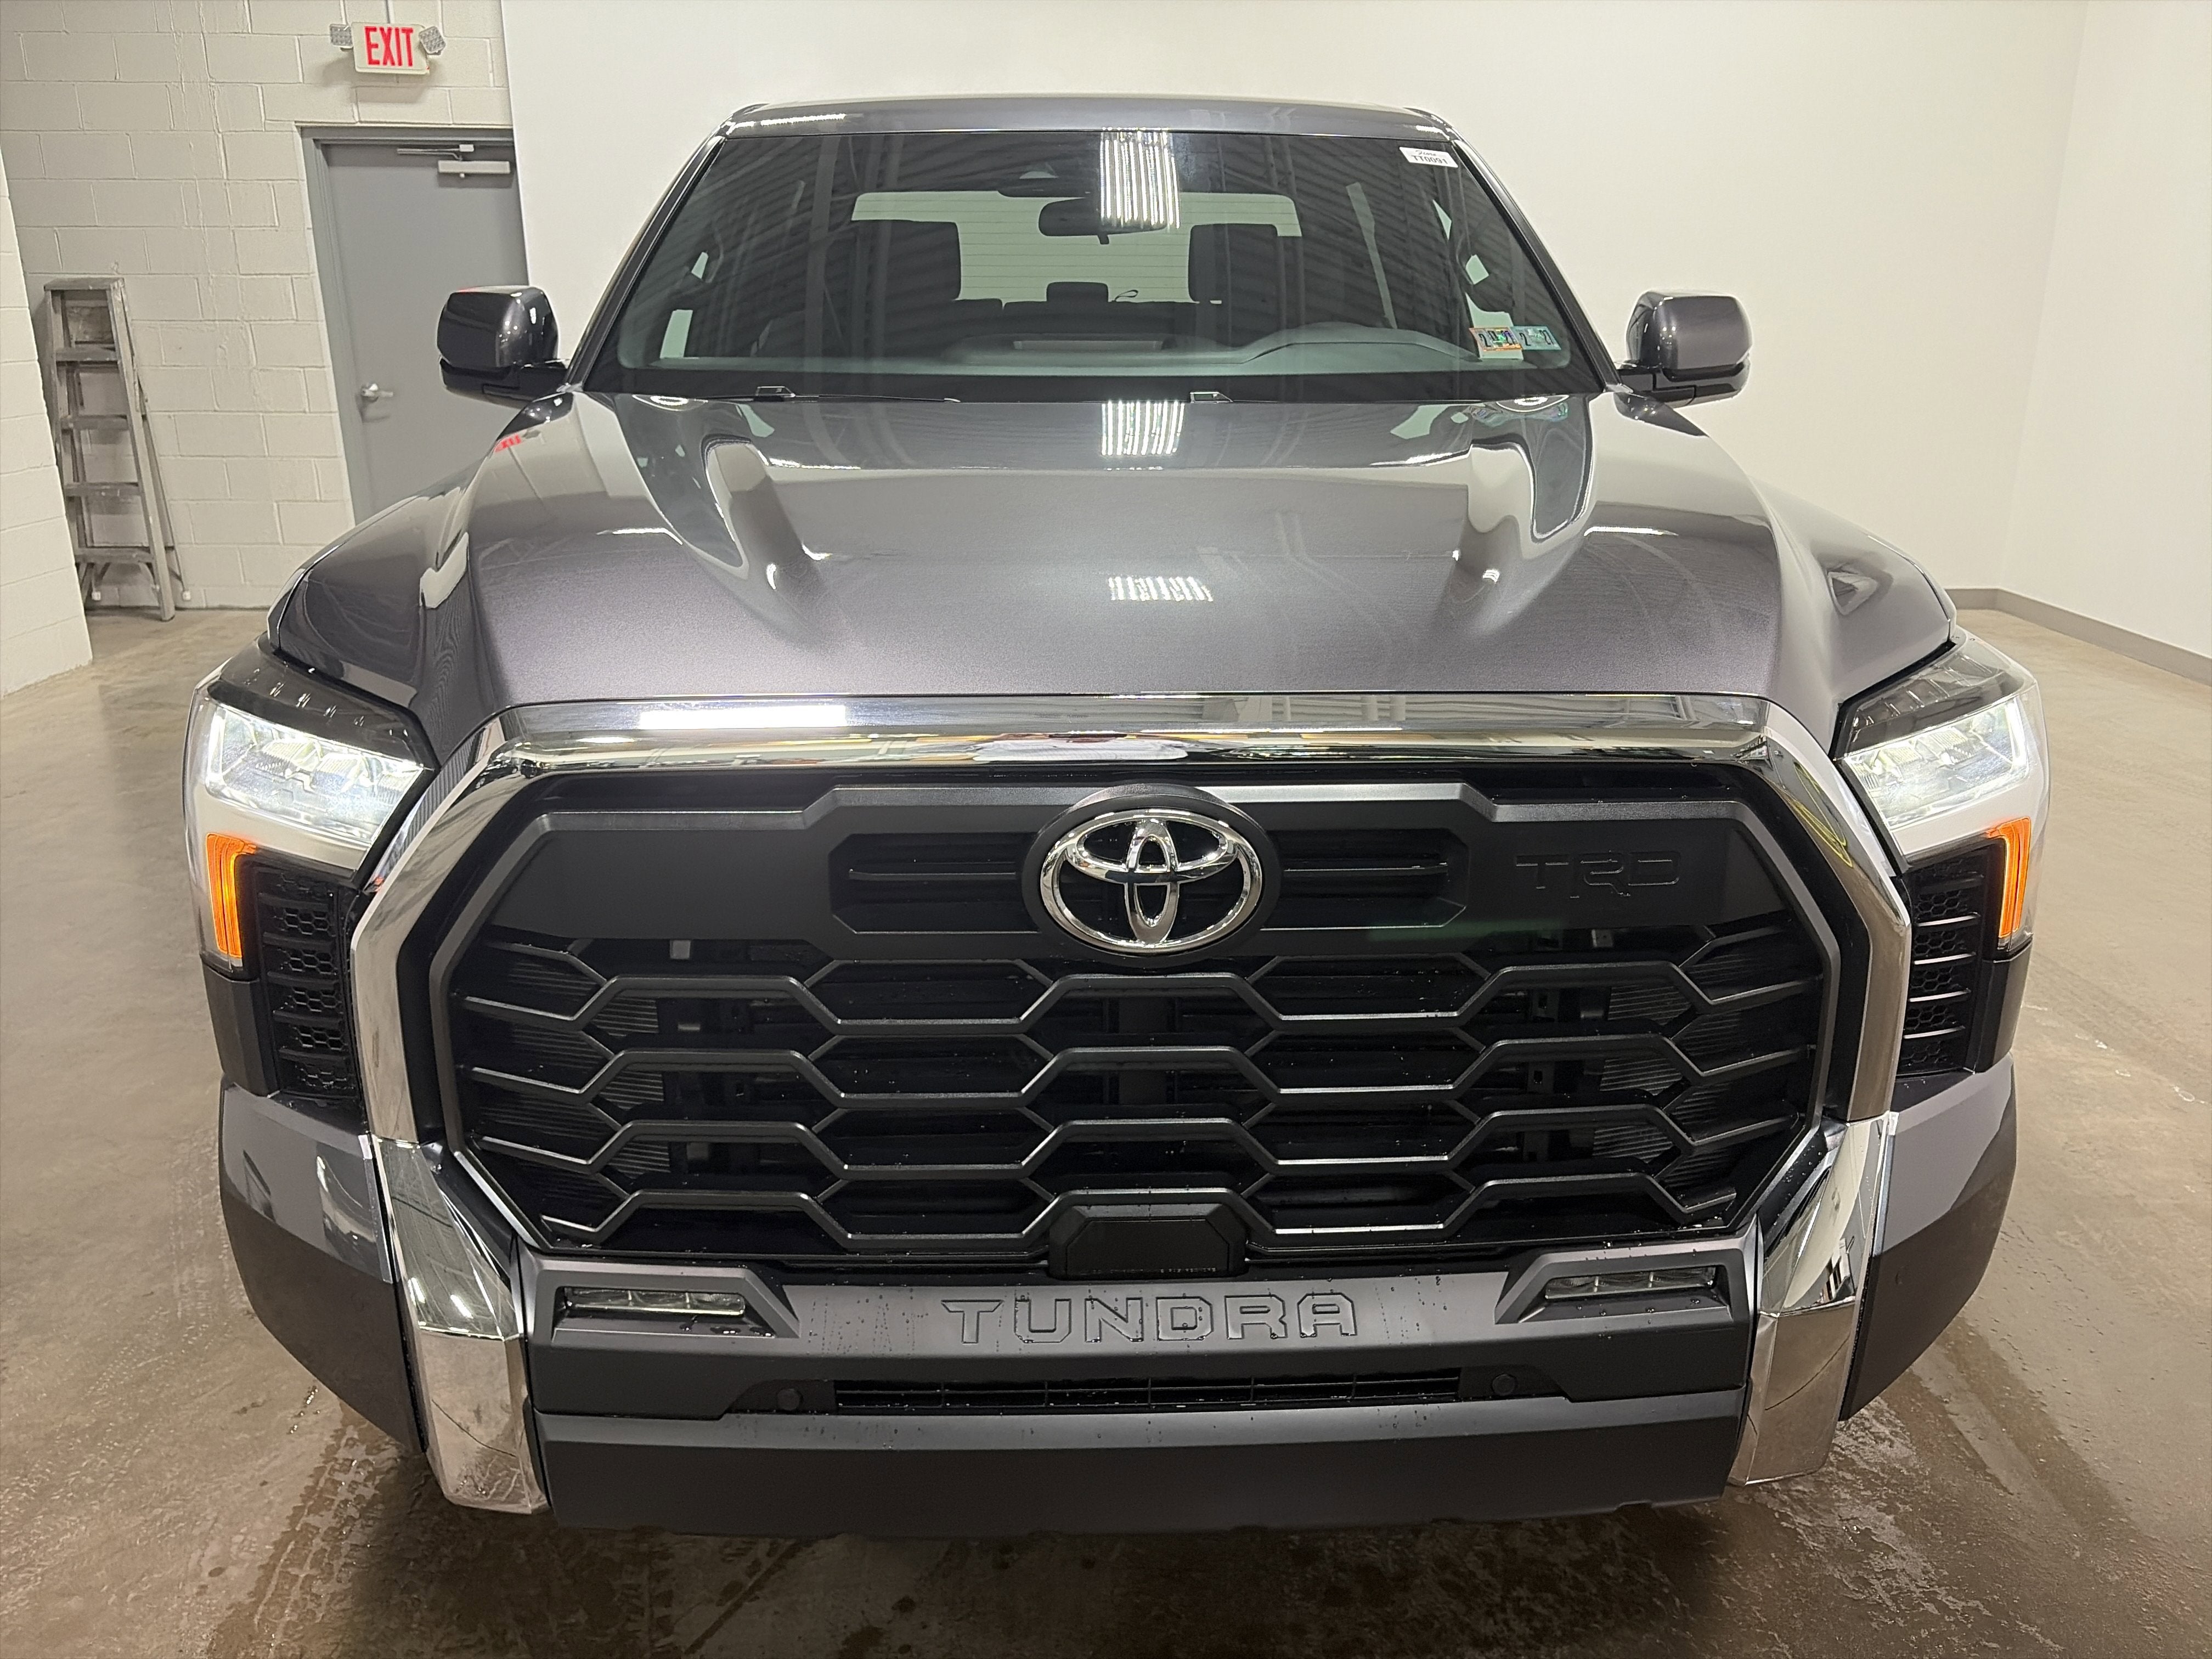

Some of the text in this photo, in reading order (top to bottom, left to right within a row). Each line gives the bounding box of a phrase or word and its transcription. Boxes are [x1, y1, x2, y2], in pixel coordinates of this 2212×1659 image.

[364, 26, 414, 66] EXIT
[1411, 155, 1448, 164] TT0091
[1519, 333, 1531, 346] 2
[1515, 851, 1681, 899] TRD
[941, 1293, 1357, 1344] TUNDRA
